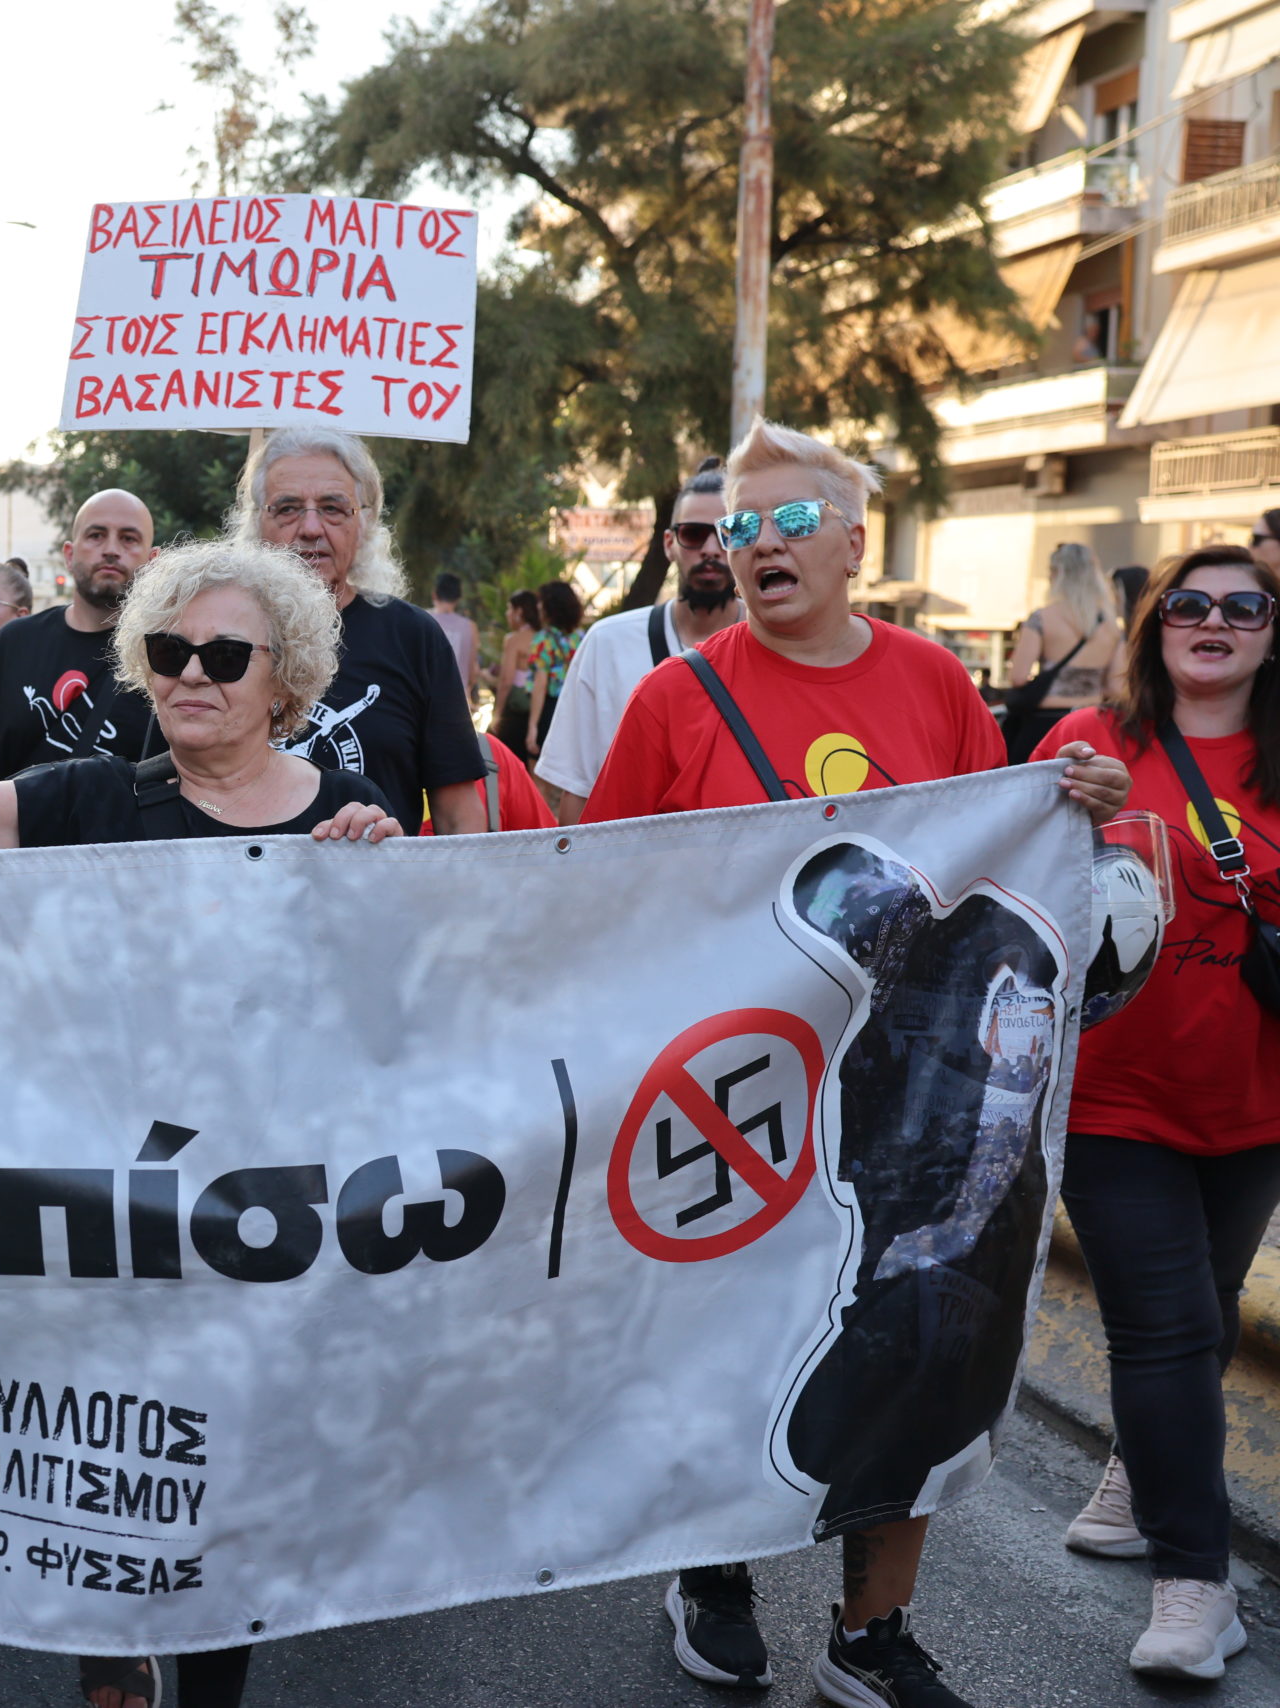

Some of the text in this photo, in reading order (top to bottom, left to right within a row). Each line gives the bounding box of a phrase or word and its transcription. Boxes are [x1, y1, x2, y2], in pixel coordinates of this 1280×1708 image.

[89, 198, 474, 258] ΒΑΣΙΛΕΙΟΣ ΜΑΓΓΟΣ
[139, 247, 396, 301] ΤΙΜΩΡΙΑ
[69, 311, 464, 369] ΣΤΟΥΣ ΕΓΚΛΗΜΑΤΙΕΣ
[75, 369, 462, 421] ΒΑΣΑΝΙΣΤΕΣ ΤΟΥ
[26, 1538, 203, 1595] ΦΥΣΣΑΣ
